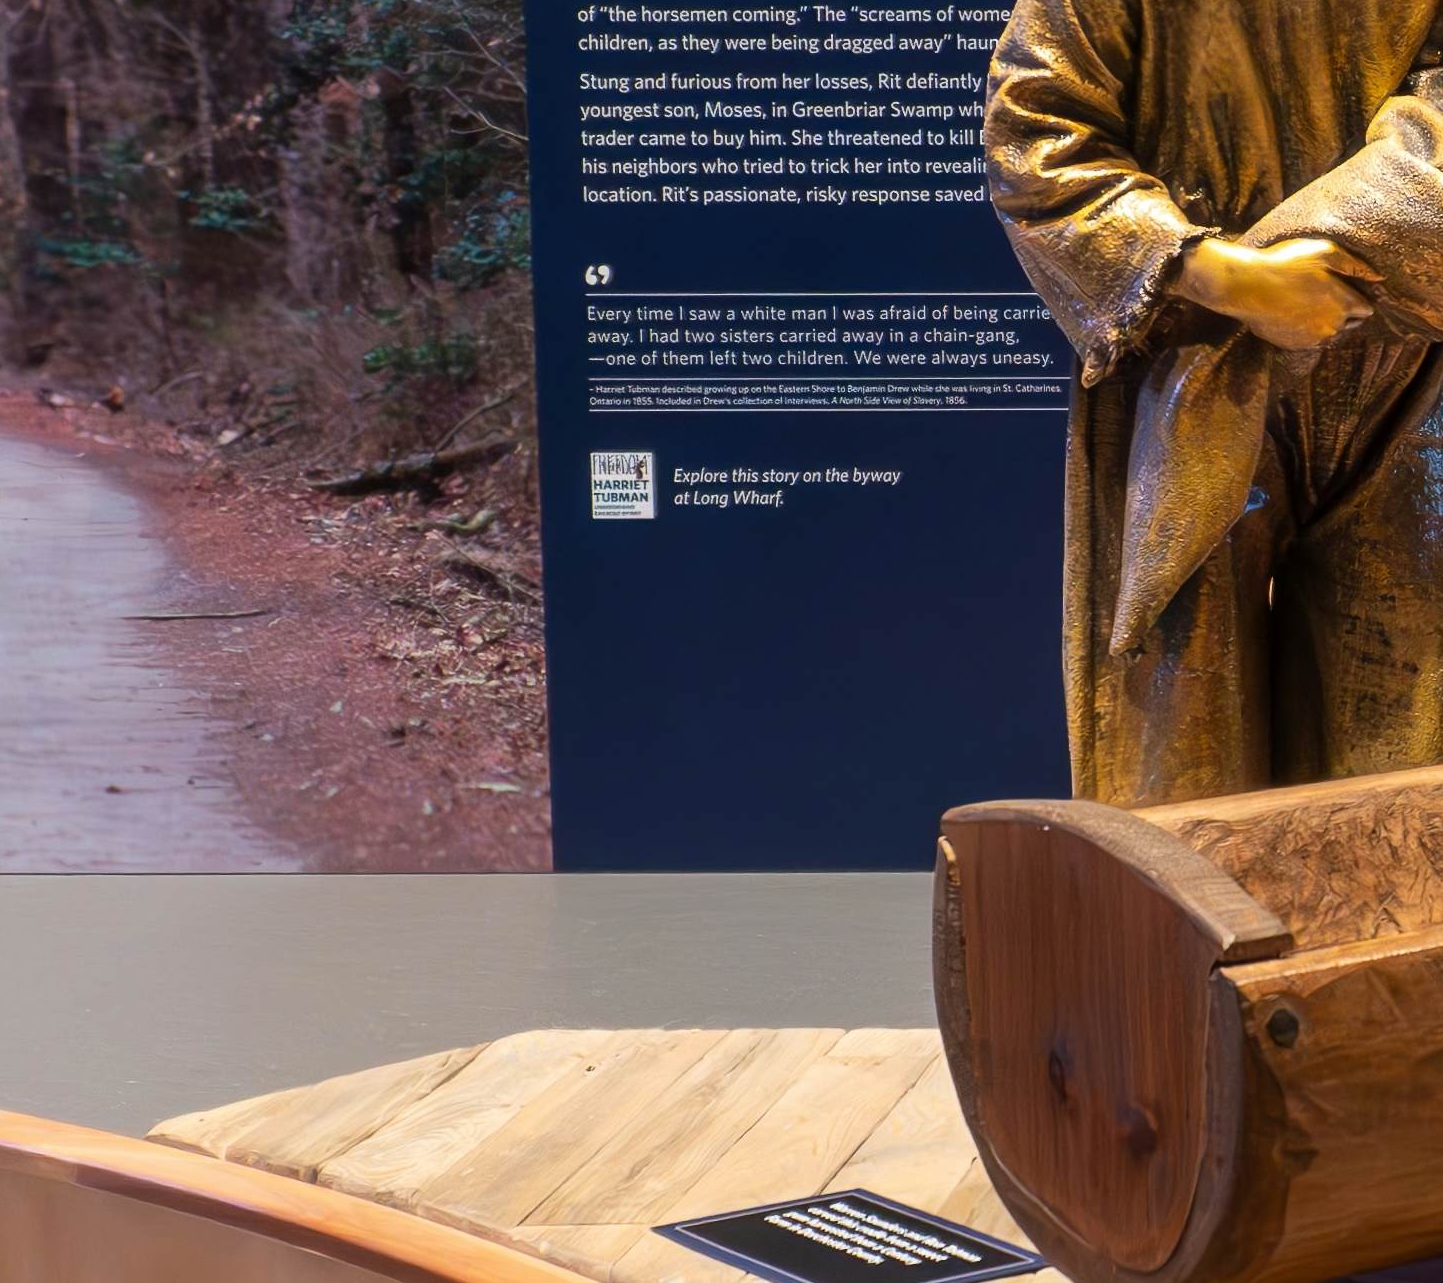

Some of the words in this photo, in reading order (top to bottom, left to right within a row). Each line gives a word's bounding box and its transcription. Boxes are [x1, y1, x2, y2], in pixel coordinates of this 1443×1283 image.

[587, 331, 634, 347] away.
[639, 328, 643, 343] I
[649, 328, 679, 344] had
[684, 329, 715, 344] two
[720, 328, 775, 344] sisters
[779, 327, 837, 343] carried
[842, 331, 884, 346] away
[889, 328, 904, 343] in
[909, 331, 919, 343] a
[923, 327, 1020, 346] chain-gang,
[594, 480, 649, 490] HARRIET
[673, 466, 728, 486] Explore
[731, 467, 759, 483] this
[761, 468, 800, 486] story
[802, 471, 822, 483] on
[825, 467, 849, 483] the
[852, 466, 901, 486] byway
[594, 493, 648, 502] TUBMAN
[673, 491, 691, 505] at
[693, 490, 729, 509] Long
[733, 489, 784, 508] Wharf.
